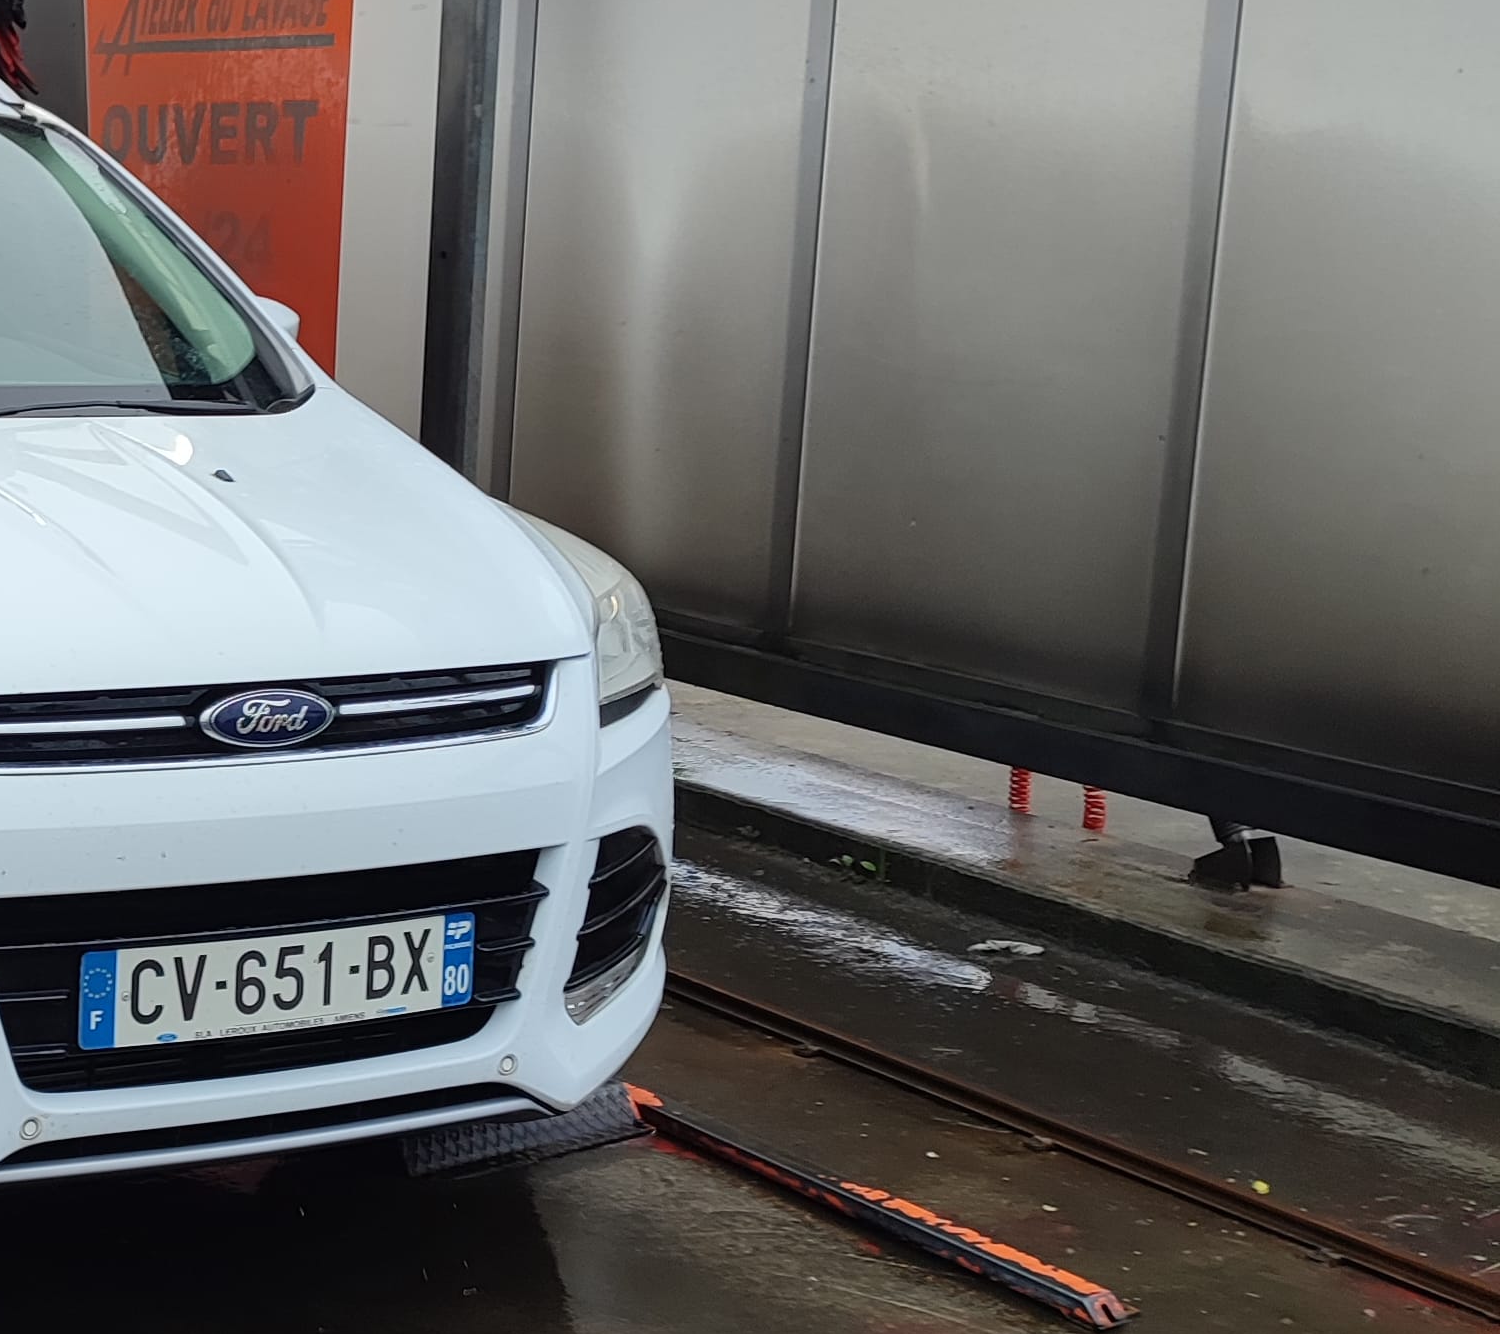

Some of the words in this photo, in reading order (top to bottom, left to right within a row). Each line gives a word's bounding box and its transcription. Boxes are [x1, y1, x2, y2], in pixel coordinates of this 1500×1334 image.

[102, 99, 320, 166] OUVERT
[235, 698, 309, 734] Ford
[130, 928, 432, 1025] CV-651-BX
[443, 963, 469, 996] 80
[89, 1010, 102, 1030] F
